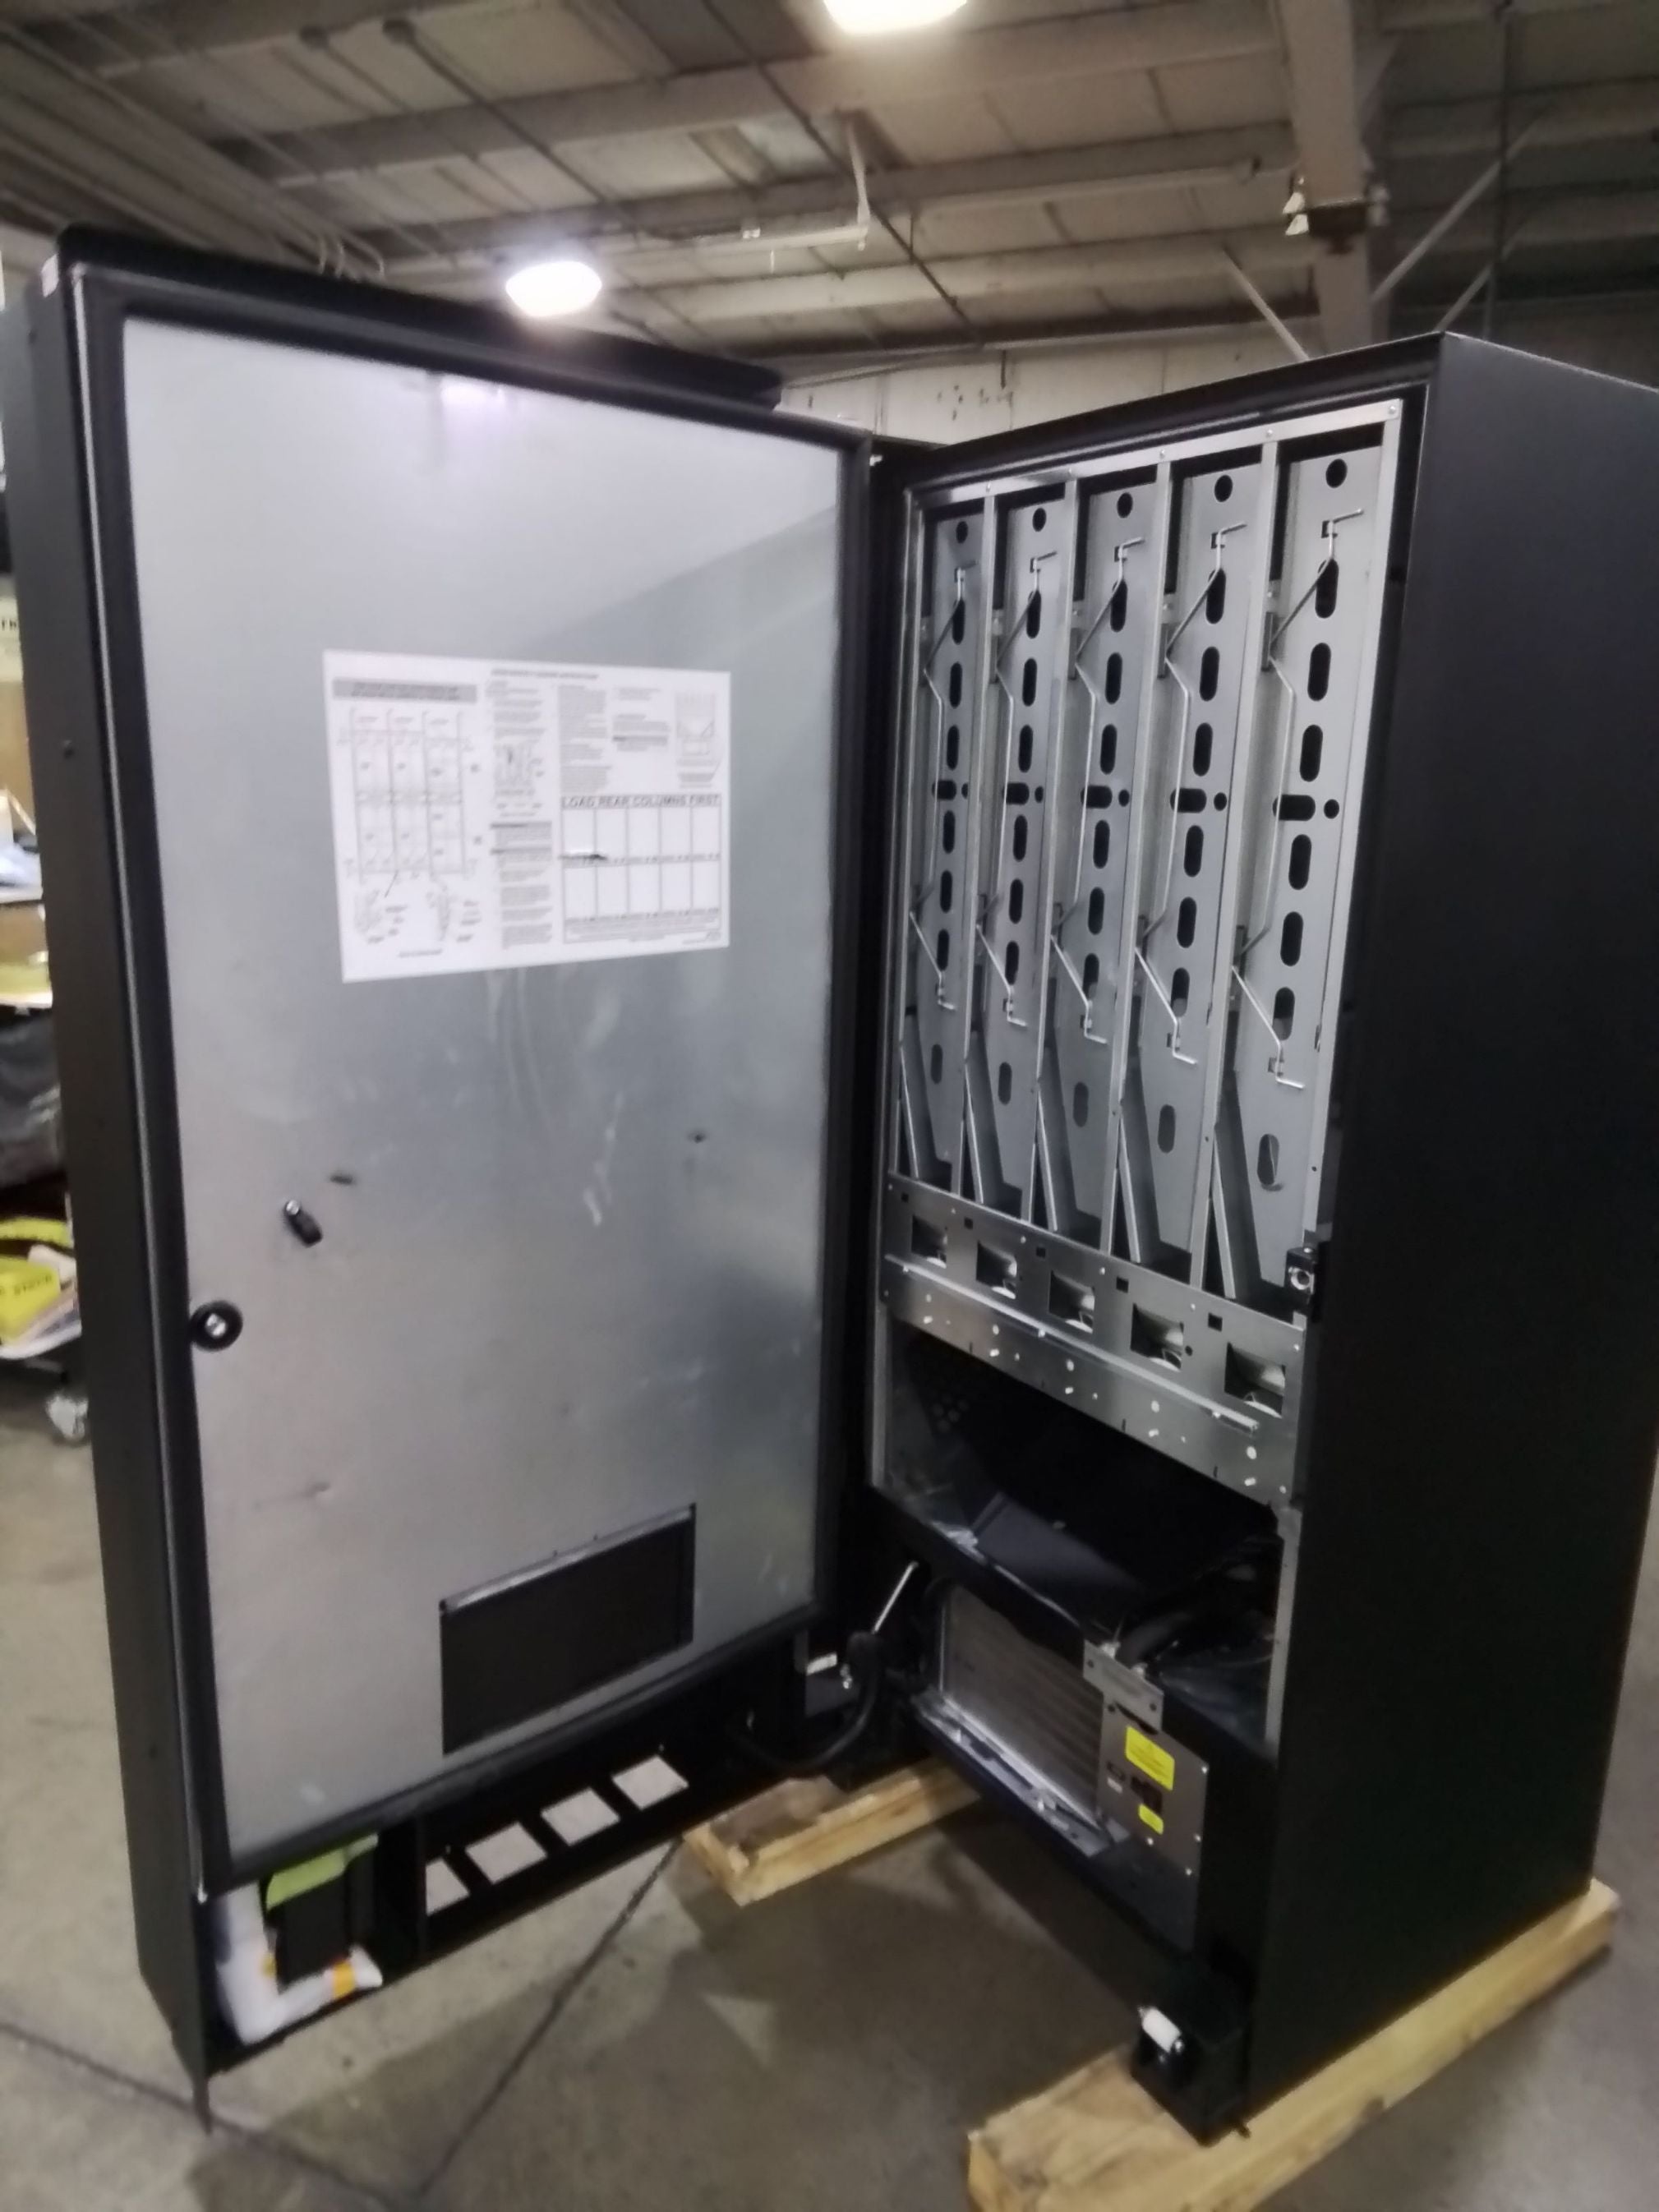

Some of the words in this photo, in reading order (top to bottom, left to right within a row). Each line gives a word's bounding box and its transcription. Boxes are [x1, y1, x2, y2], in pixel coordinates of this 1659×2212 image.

[563, 796, 596, 809] LOAD
[598, 796, 629, 809] REAR
[632, 795, 685, 809] COLUMNS
[689, 795, 719, 807] FIRST
